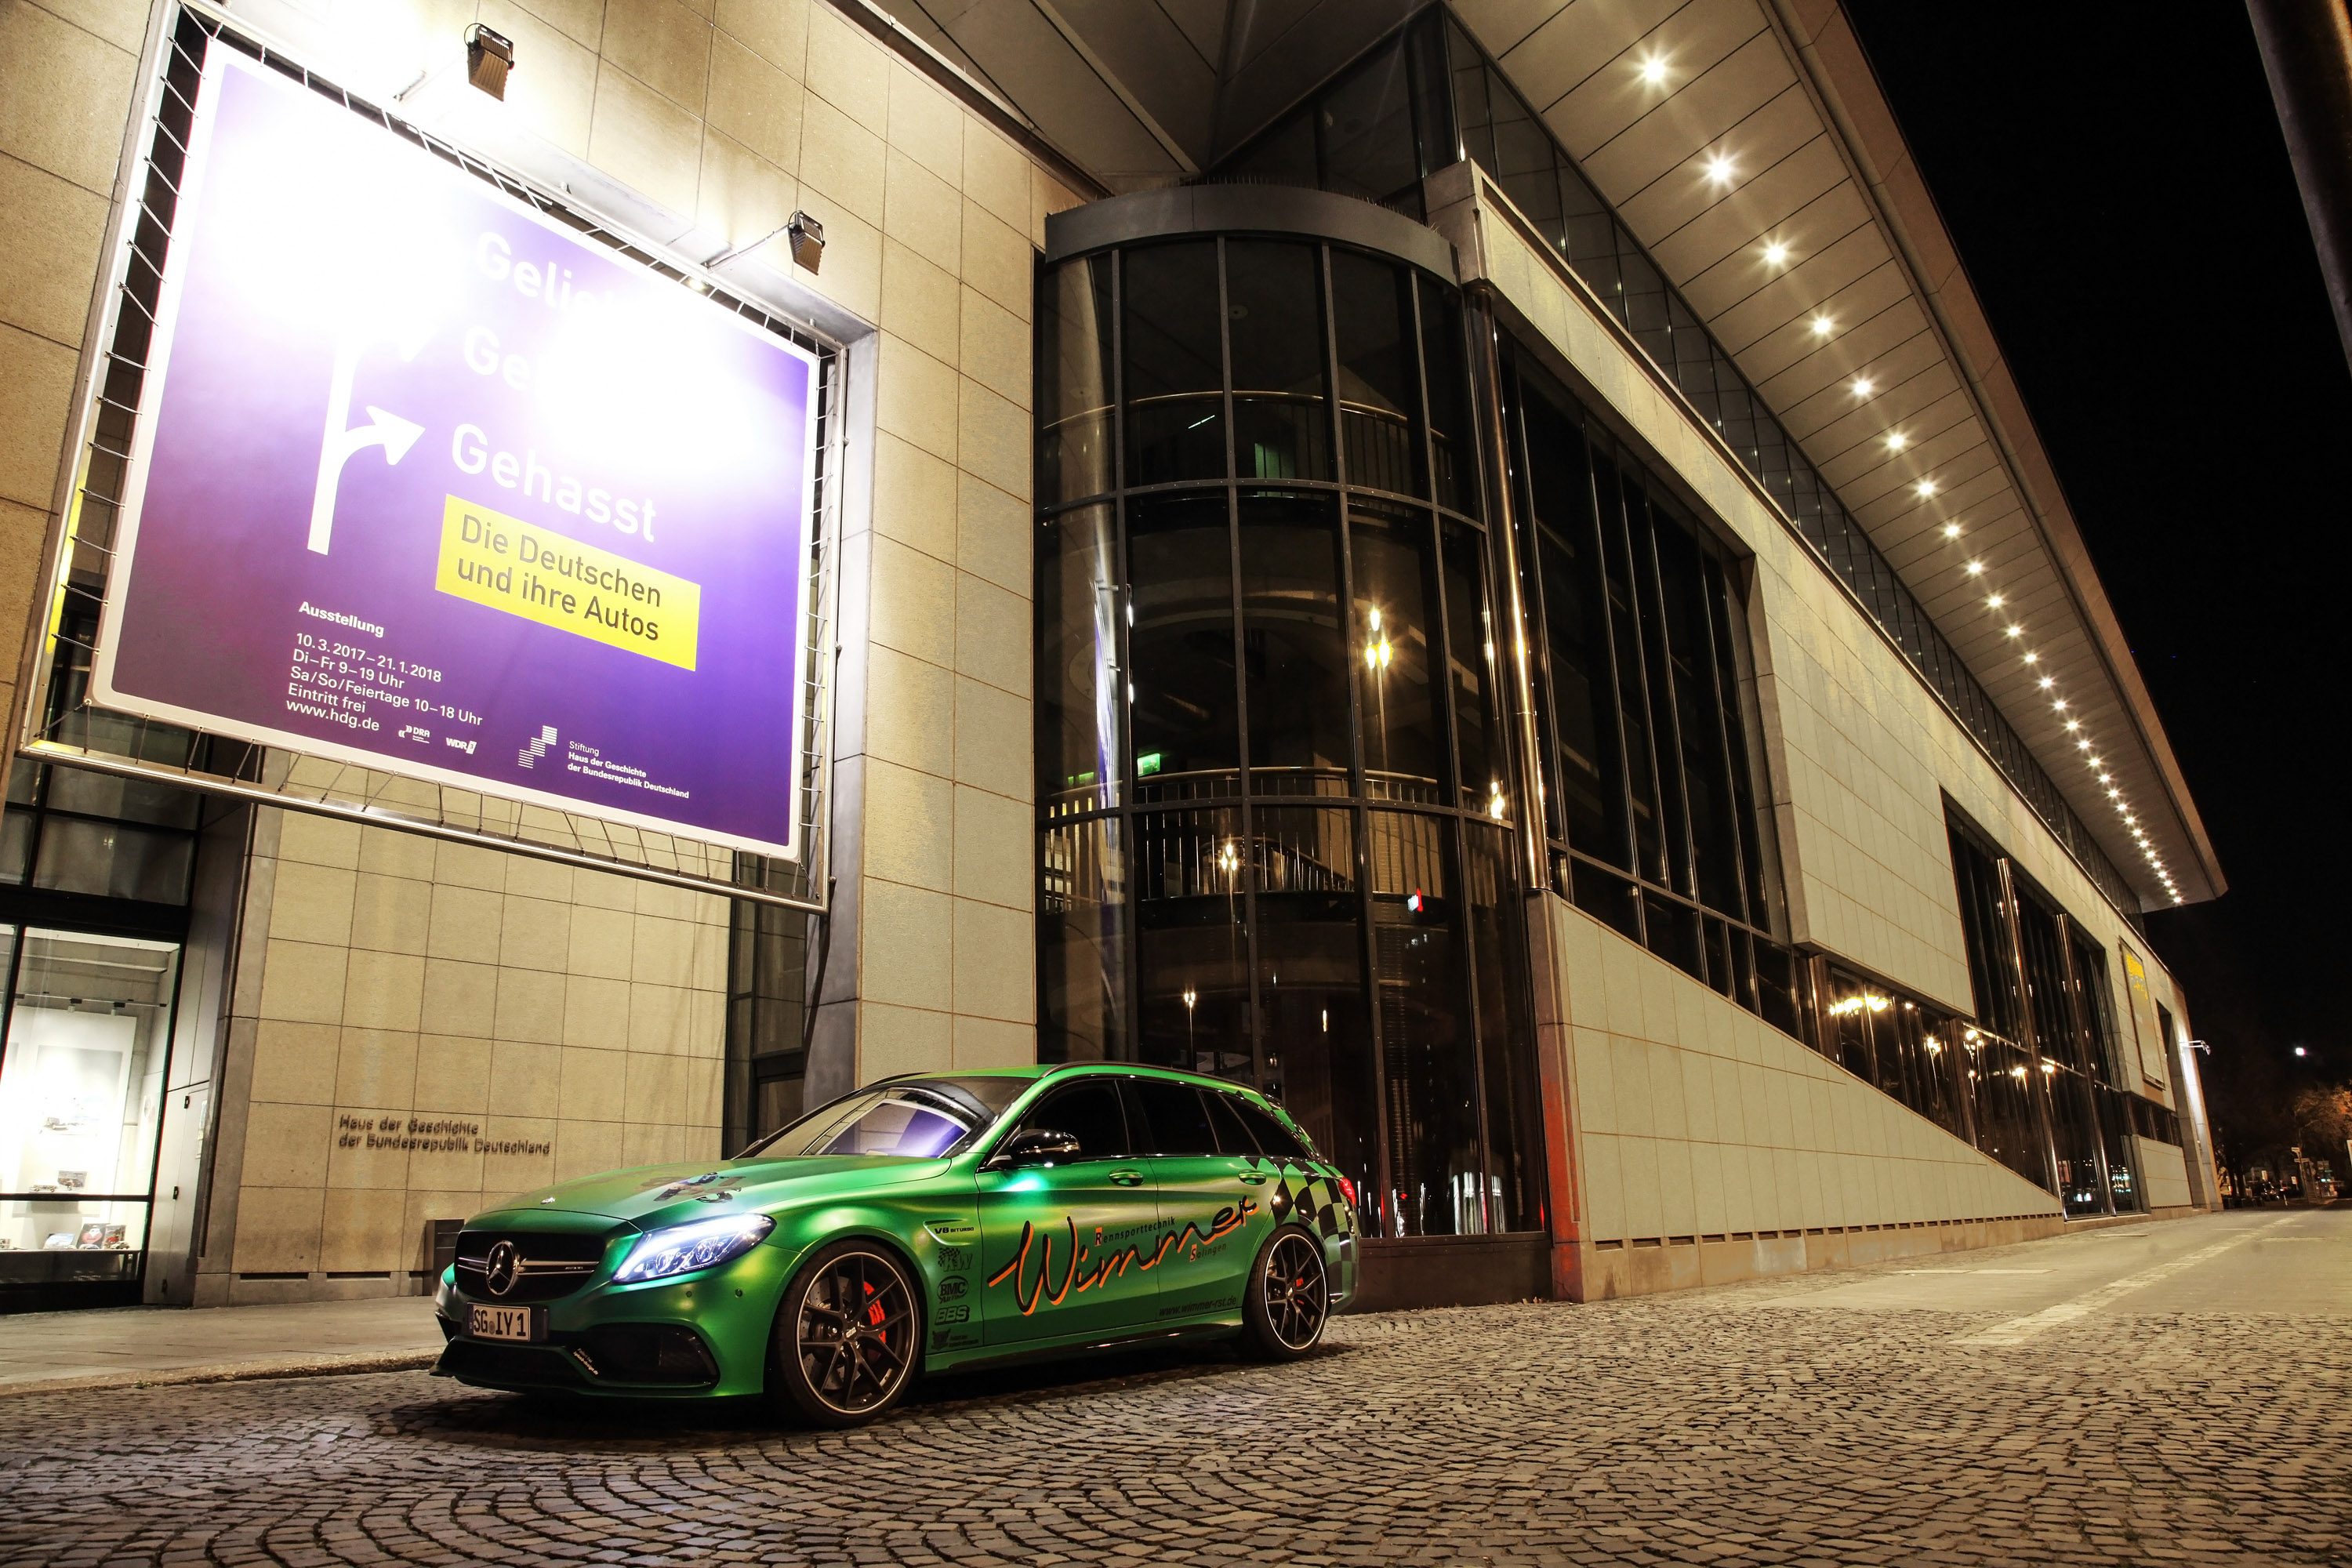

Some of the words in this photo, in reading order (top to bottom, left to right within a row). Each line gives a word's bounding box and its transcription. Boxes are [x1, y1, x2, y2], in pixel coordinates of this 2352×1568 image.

[452, 423, 657, 543] Gehasst
[462, 514, 508, 554] Die
[519, 534, 661, 607] Deutschen
[457, 557, 514, 593] und
[523, 572, 576, 614] ihre
[584, 595, 659, 641] Autos
[298, 601, 384, 637] Ausstellung
[379, 671, 405, 689] Uhr
[288, 682, 339, 706] Eintritt
[343, 696, 366, 713] frei
[286, 700, 379, 731] www.hdg.de
[459, 710, 483, 726] Uhr
[412, 727, 430, 738] DRA
[569, 741, 600, 757] Stiftung
[568, 752, 589, 764] Haus
[590, 757, 604, 768] der
[605, 760, 647, 778] Geschichte
[568, 763, 582, 773] der
[583, 765, 643, 787] Bundesrepublik
[644, 781, 690, 799] Deutschland
[339, 1114, 373, 1131] Haus
[379, 1116, 402, 1132] der
[408, 1117, 480, 1135] Geschichte
[339, 1133, 362, 1149] der
[366, 1133, 469, 1152] Bundesrepublik
[474, 1137, 550, 1155] Deutschland
[1094, 1216, 1176, 1247] Rennsporttechnik
[987, 1196, 1259, 1316] Wimmer
[1189, 1243, 1227, 1261] Solingen
[940, 1281, 966, 1296] BMC
[935, 1305, 971, 1326] BBS
[1158, 1295, 1237, 1317] www.wimmer-rst.de
[474, 1308, 488, 1334] SG
[495, 1312, 514, 1335] IY
[517, 1313, 527, 1337] 1
